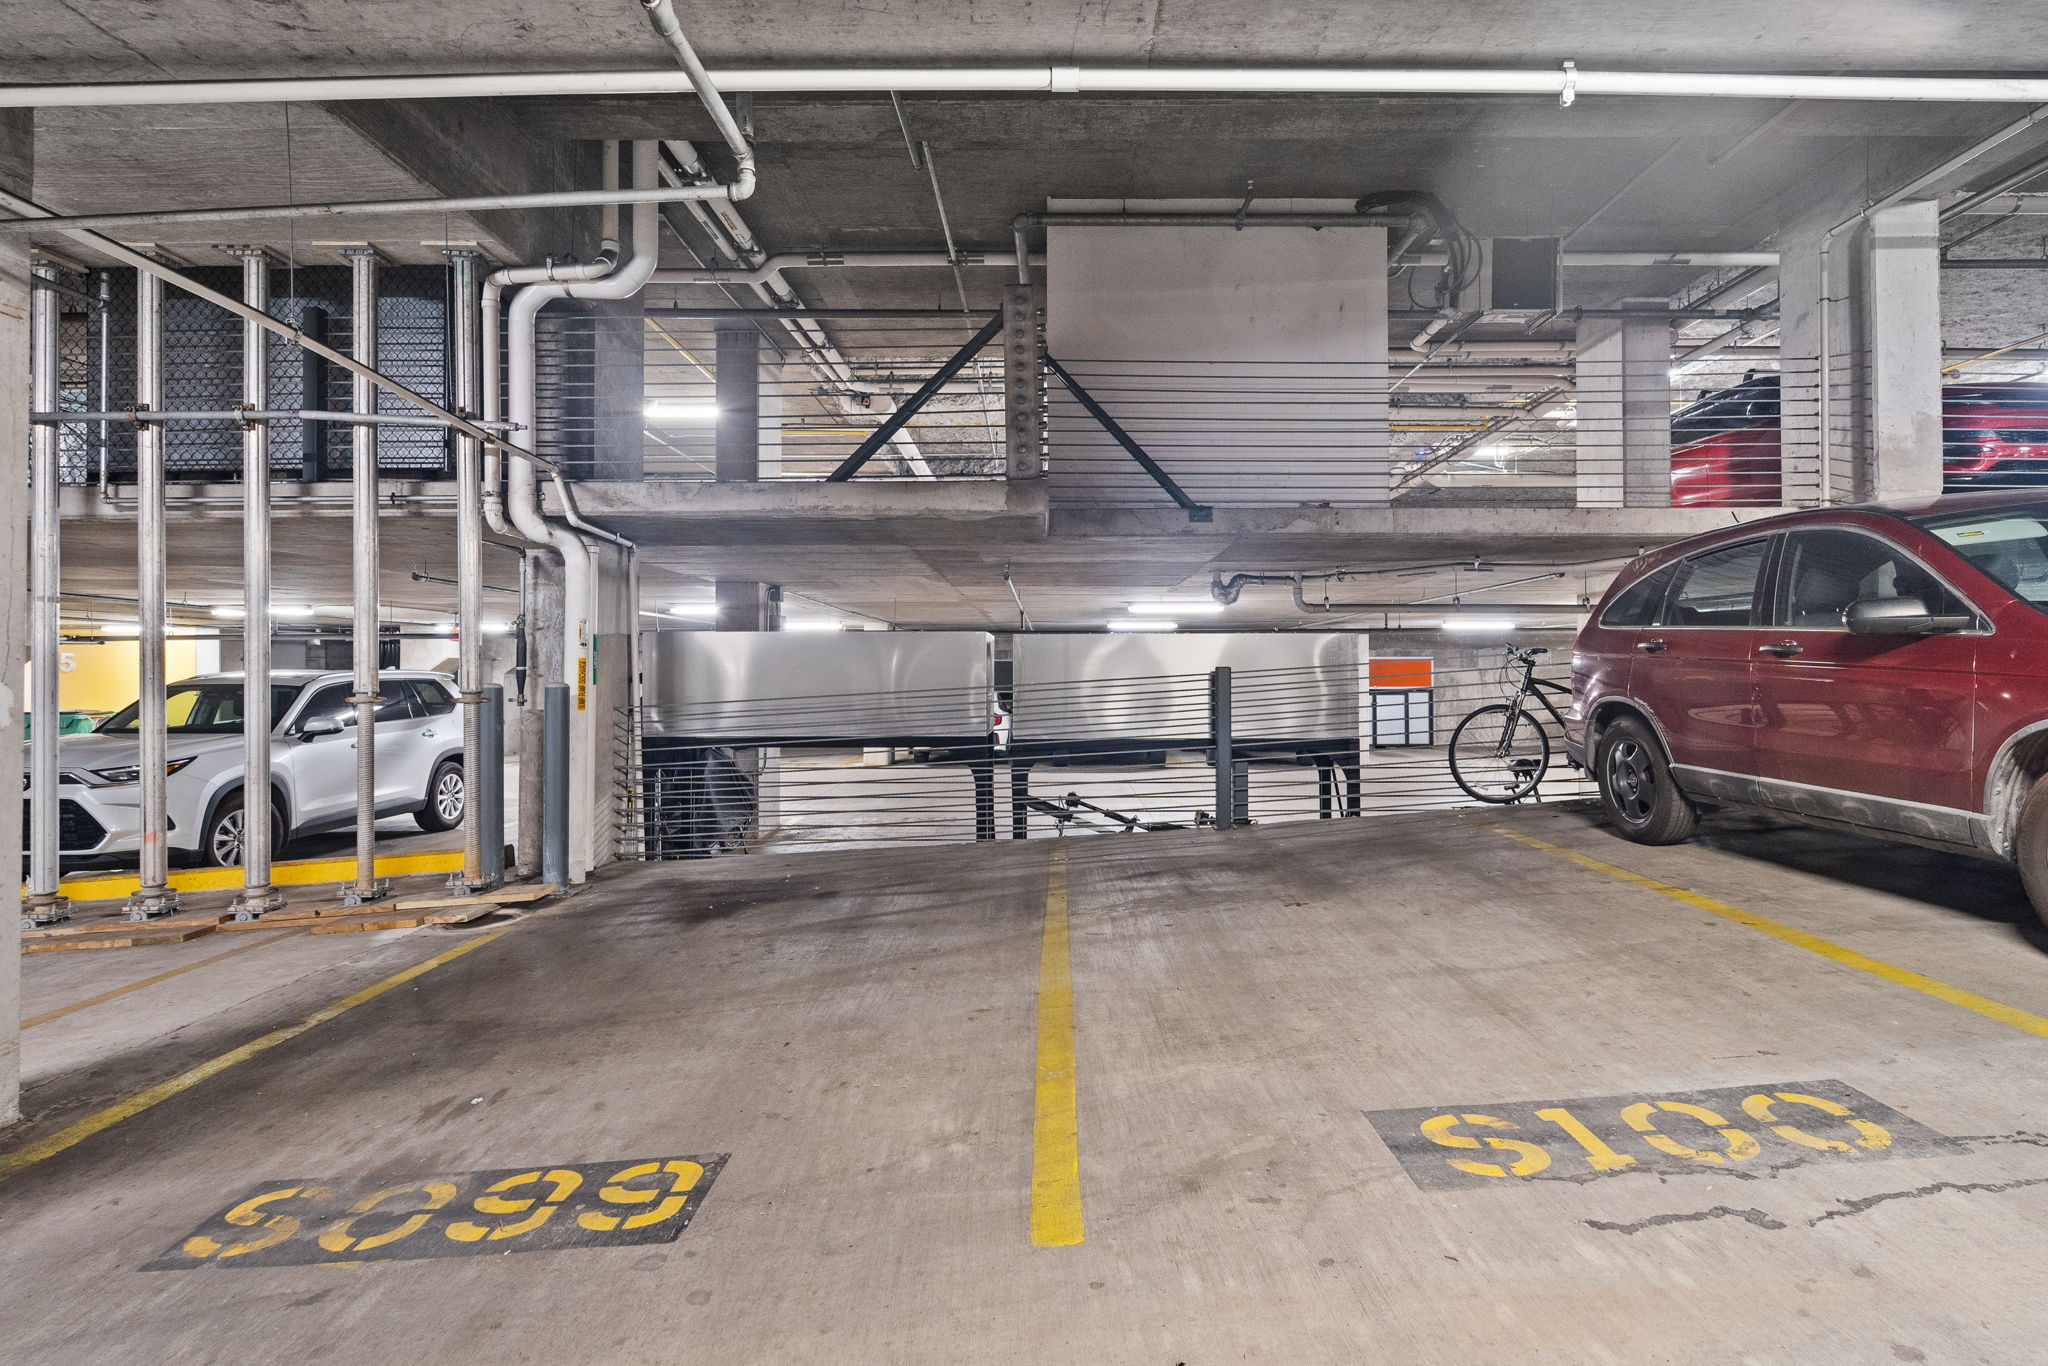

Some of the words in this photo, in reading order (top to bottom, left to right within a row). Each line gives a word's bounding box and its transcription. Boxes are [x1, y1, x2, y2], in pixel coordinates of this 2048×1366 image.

[59, 652, 76, 673] 5
[578, 661, 586, 683] DISCHARGE
[578, 685, 586, 697] PUMP
[1418, 1091, 1893, 1178] S100
[182, 1159, 704, 1259] S099
